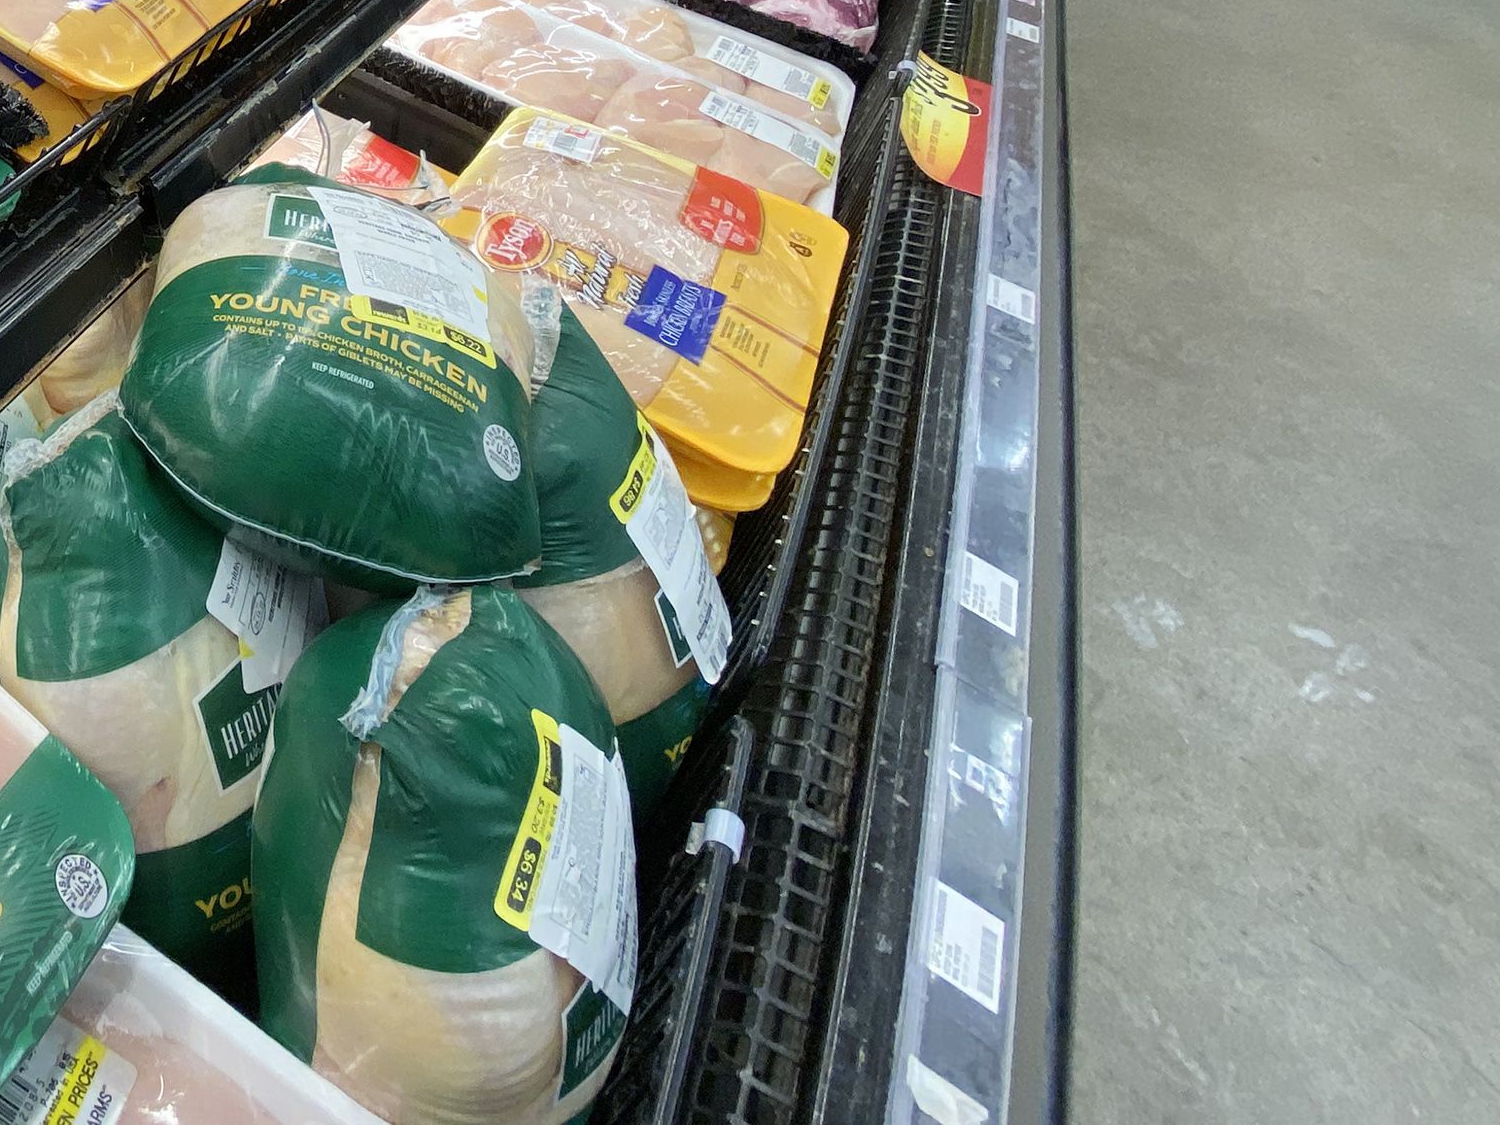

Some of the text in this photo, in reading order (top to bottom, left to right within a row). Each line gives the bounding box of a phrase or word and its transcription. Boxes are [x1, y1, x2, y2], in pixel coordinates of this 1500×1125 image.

[484, 217, 534, 262] Tyson
[658, 282, 703, 347] CHICKEN BREASTS
[209, 292, 488, 403] YOUNG CHICKEN
[212, 314, 480, 414] CONTAINS UP TO CHICKEN BROTH, CARRAGEENAN
[224, 323, 466, 414] AND SALT PARTS OF GIBLETS MAY BE MISSING
[310, 361, 375, 390] KEEP REFRIGERATED
[67, 1050, 99, 1109] PRICES"
